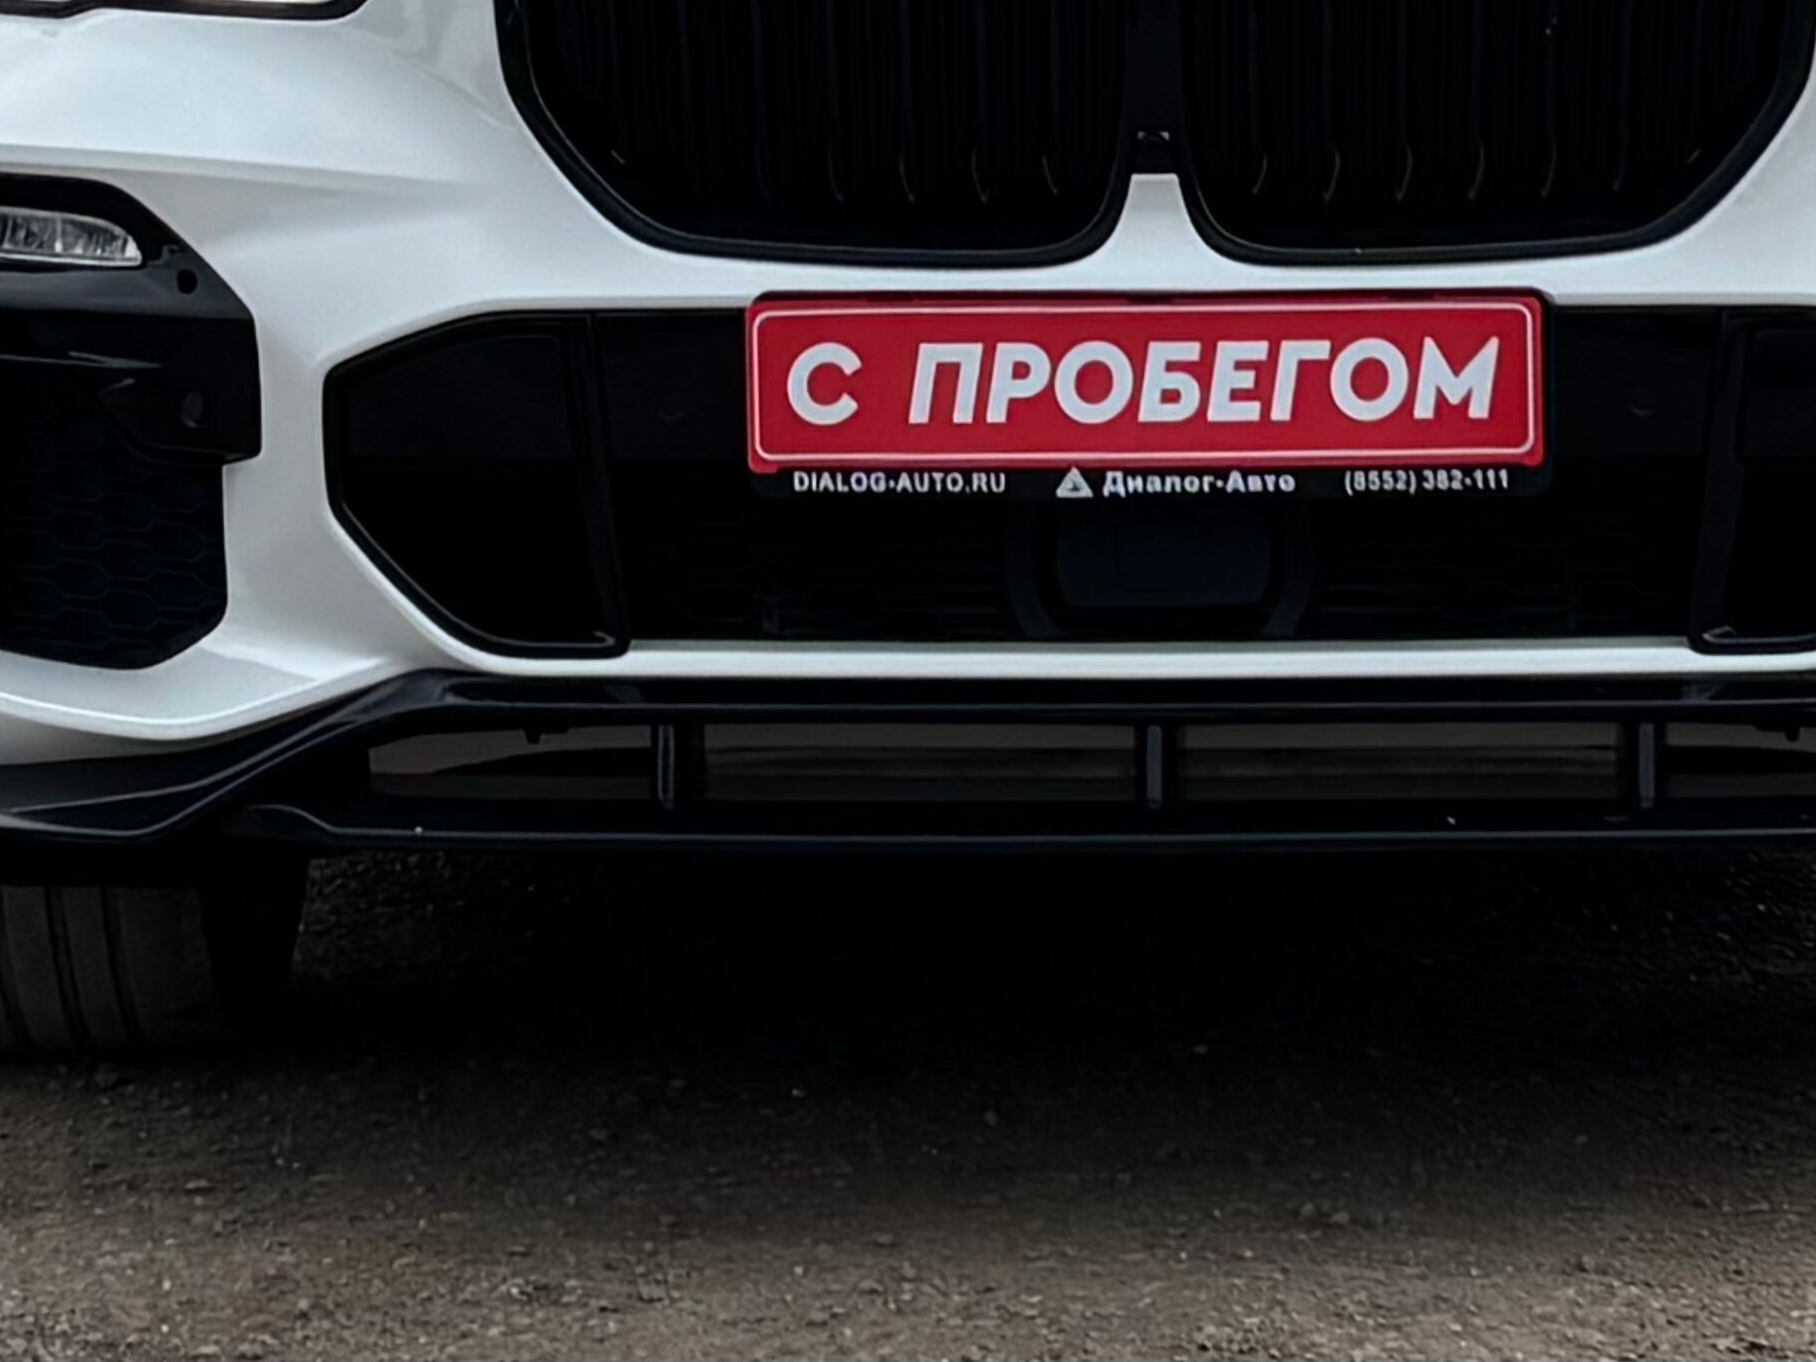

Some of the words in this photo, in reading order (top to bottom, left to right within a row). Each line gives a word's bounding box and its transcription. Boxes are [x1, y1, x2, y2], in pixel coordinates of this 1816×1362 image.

[787, 341, 864, 427] С
[907, 336, 1500, 425] ПРОБЕГОМ
[1102, 470, 1297, 499] Диалог-Авто
